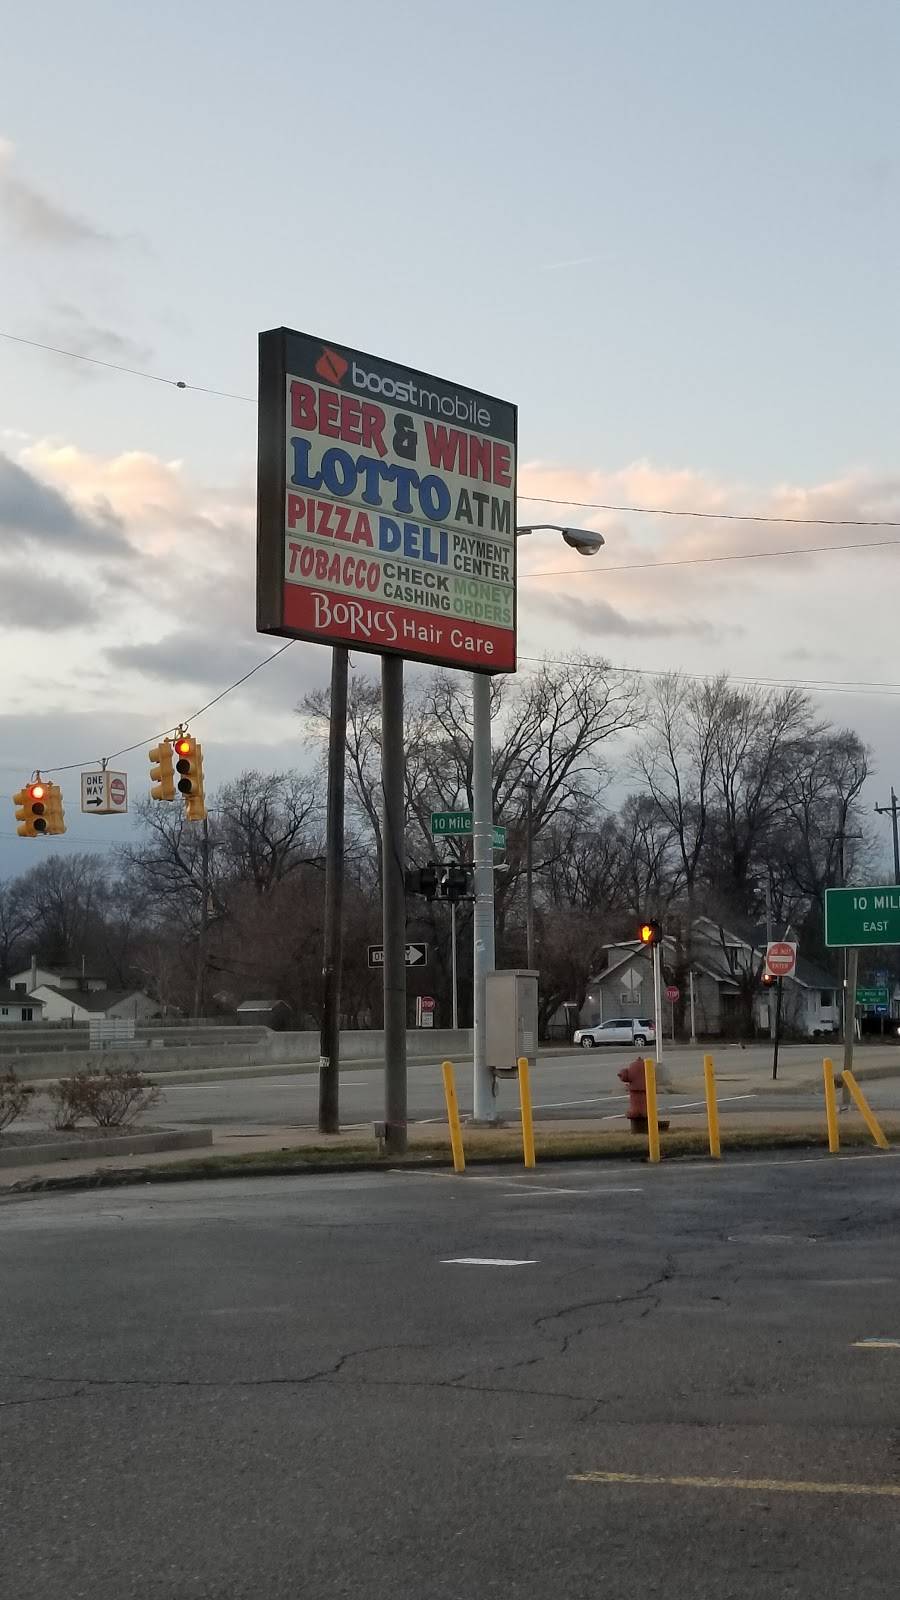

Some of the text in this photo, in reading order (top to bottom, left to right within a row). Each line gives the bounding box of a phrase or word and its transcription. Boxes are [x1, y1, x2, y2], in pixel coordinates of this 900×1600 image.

[289, 380, 512, 488] BEER & WINE
[290, 437, 452, 521] LOTTO
[454, 488, 511, 534] ATM
[287, 494, 449, 565] PIZZA DELI
[453, 534, 510, 564] PAYMENT
[288, 543, 381, 592] TOBACCO
[383, 562, 449, 592] CHECK
[453, 554, 509, 582] CENTER
[383, 582, 450, 611] CASHING
[453, 579, 511, 604] MONEY
[453, 600, 511, 623] ORDERS
[403, 618, 442, 643] Hair
[450, 630, 494, 653] Care
[87, 776, 103, 785] ONE
[87, 786, 103, 795] WAY
[434, 816, 471, 829] 10 Mile
[853, 895, 900, 910] 10 MIL
[863, 921, 888, 931] EAST
